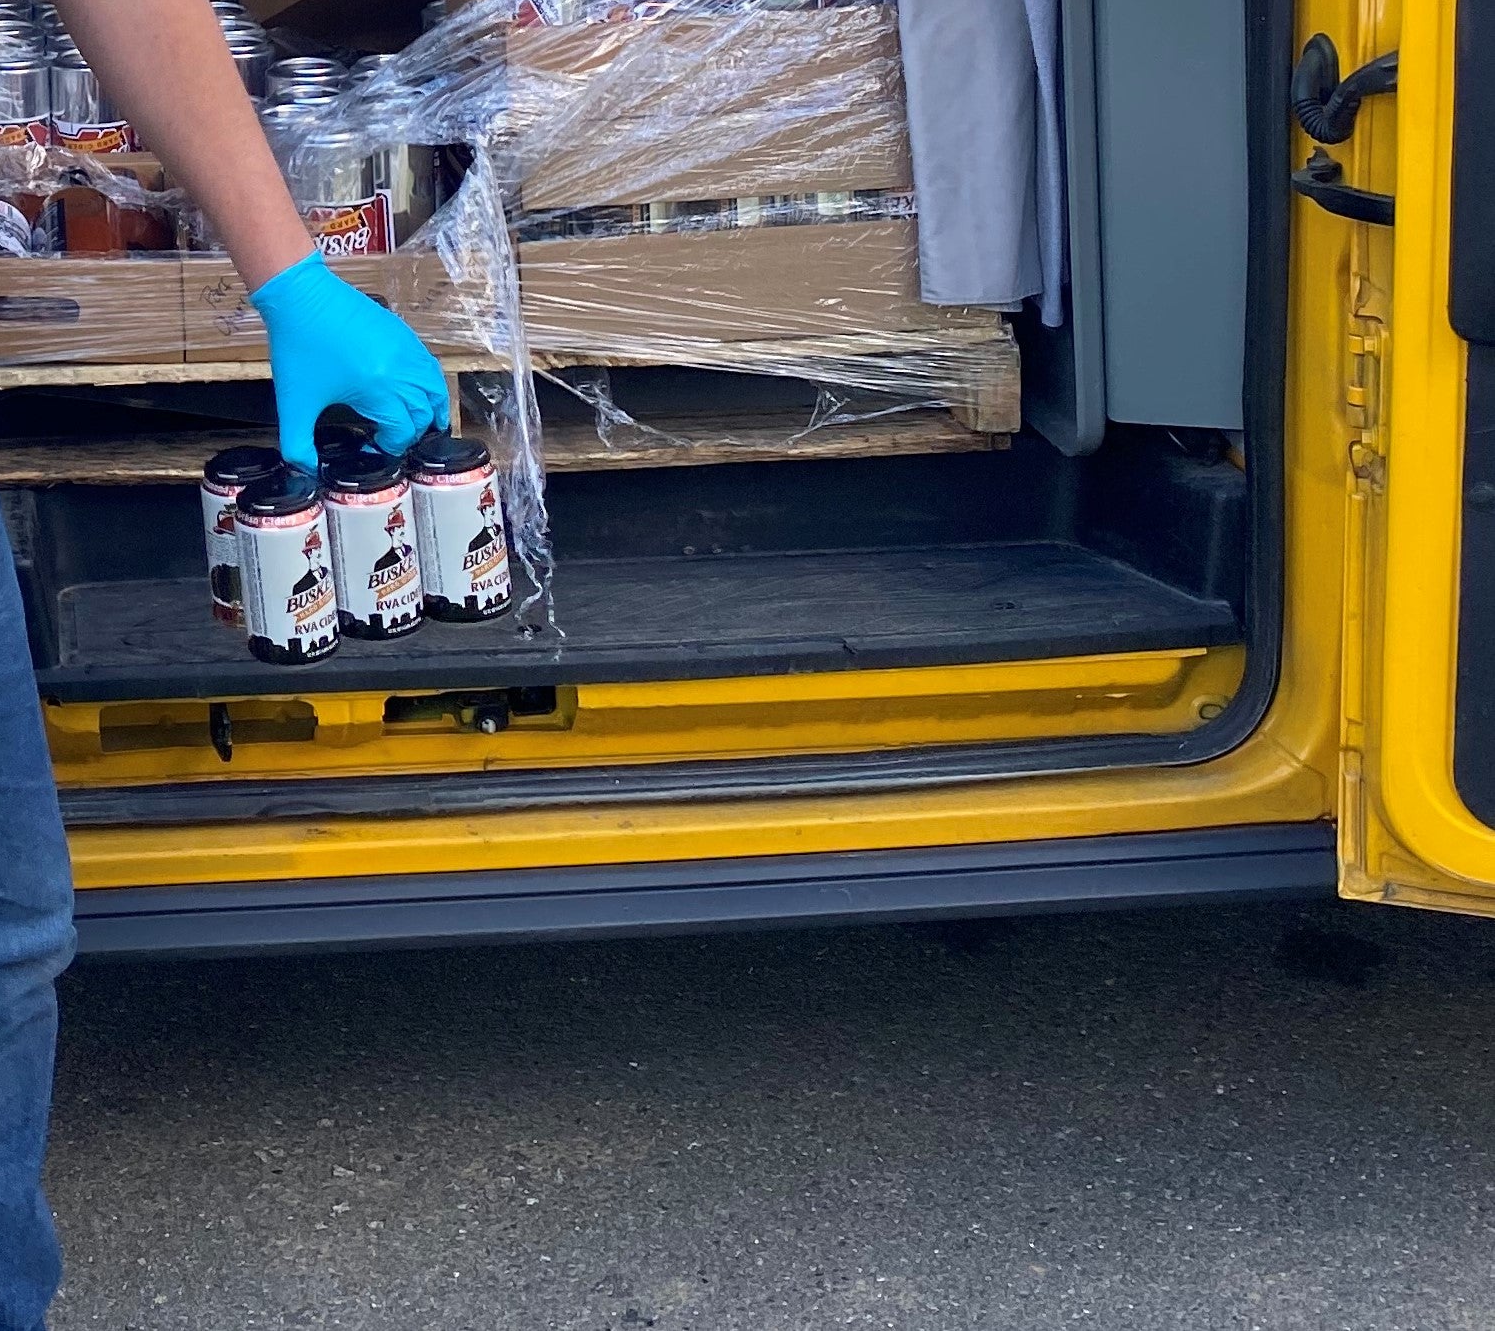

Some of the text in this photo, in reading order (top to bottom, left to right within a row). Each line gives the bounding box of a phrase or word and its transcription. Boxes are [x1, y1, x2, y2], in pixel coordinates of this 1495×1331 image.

[470, 578, 494, 593] RVA
[376, 598, 400, 611] RVA
[294, 621, 319, 636] RVA
